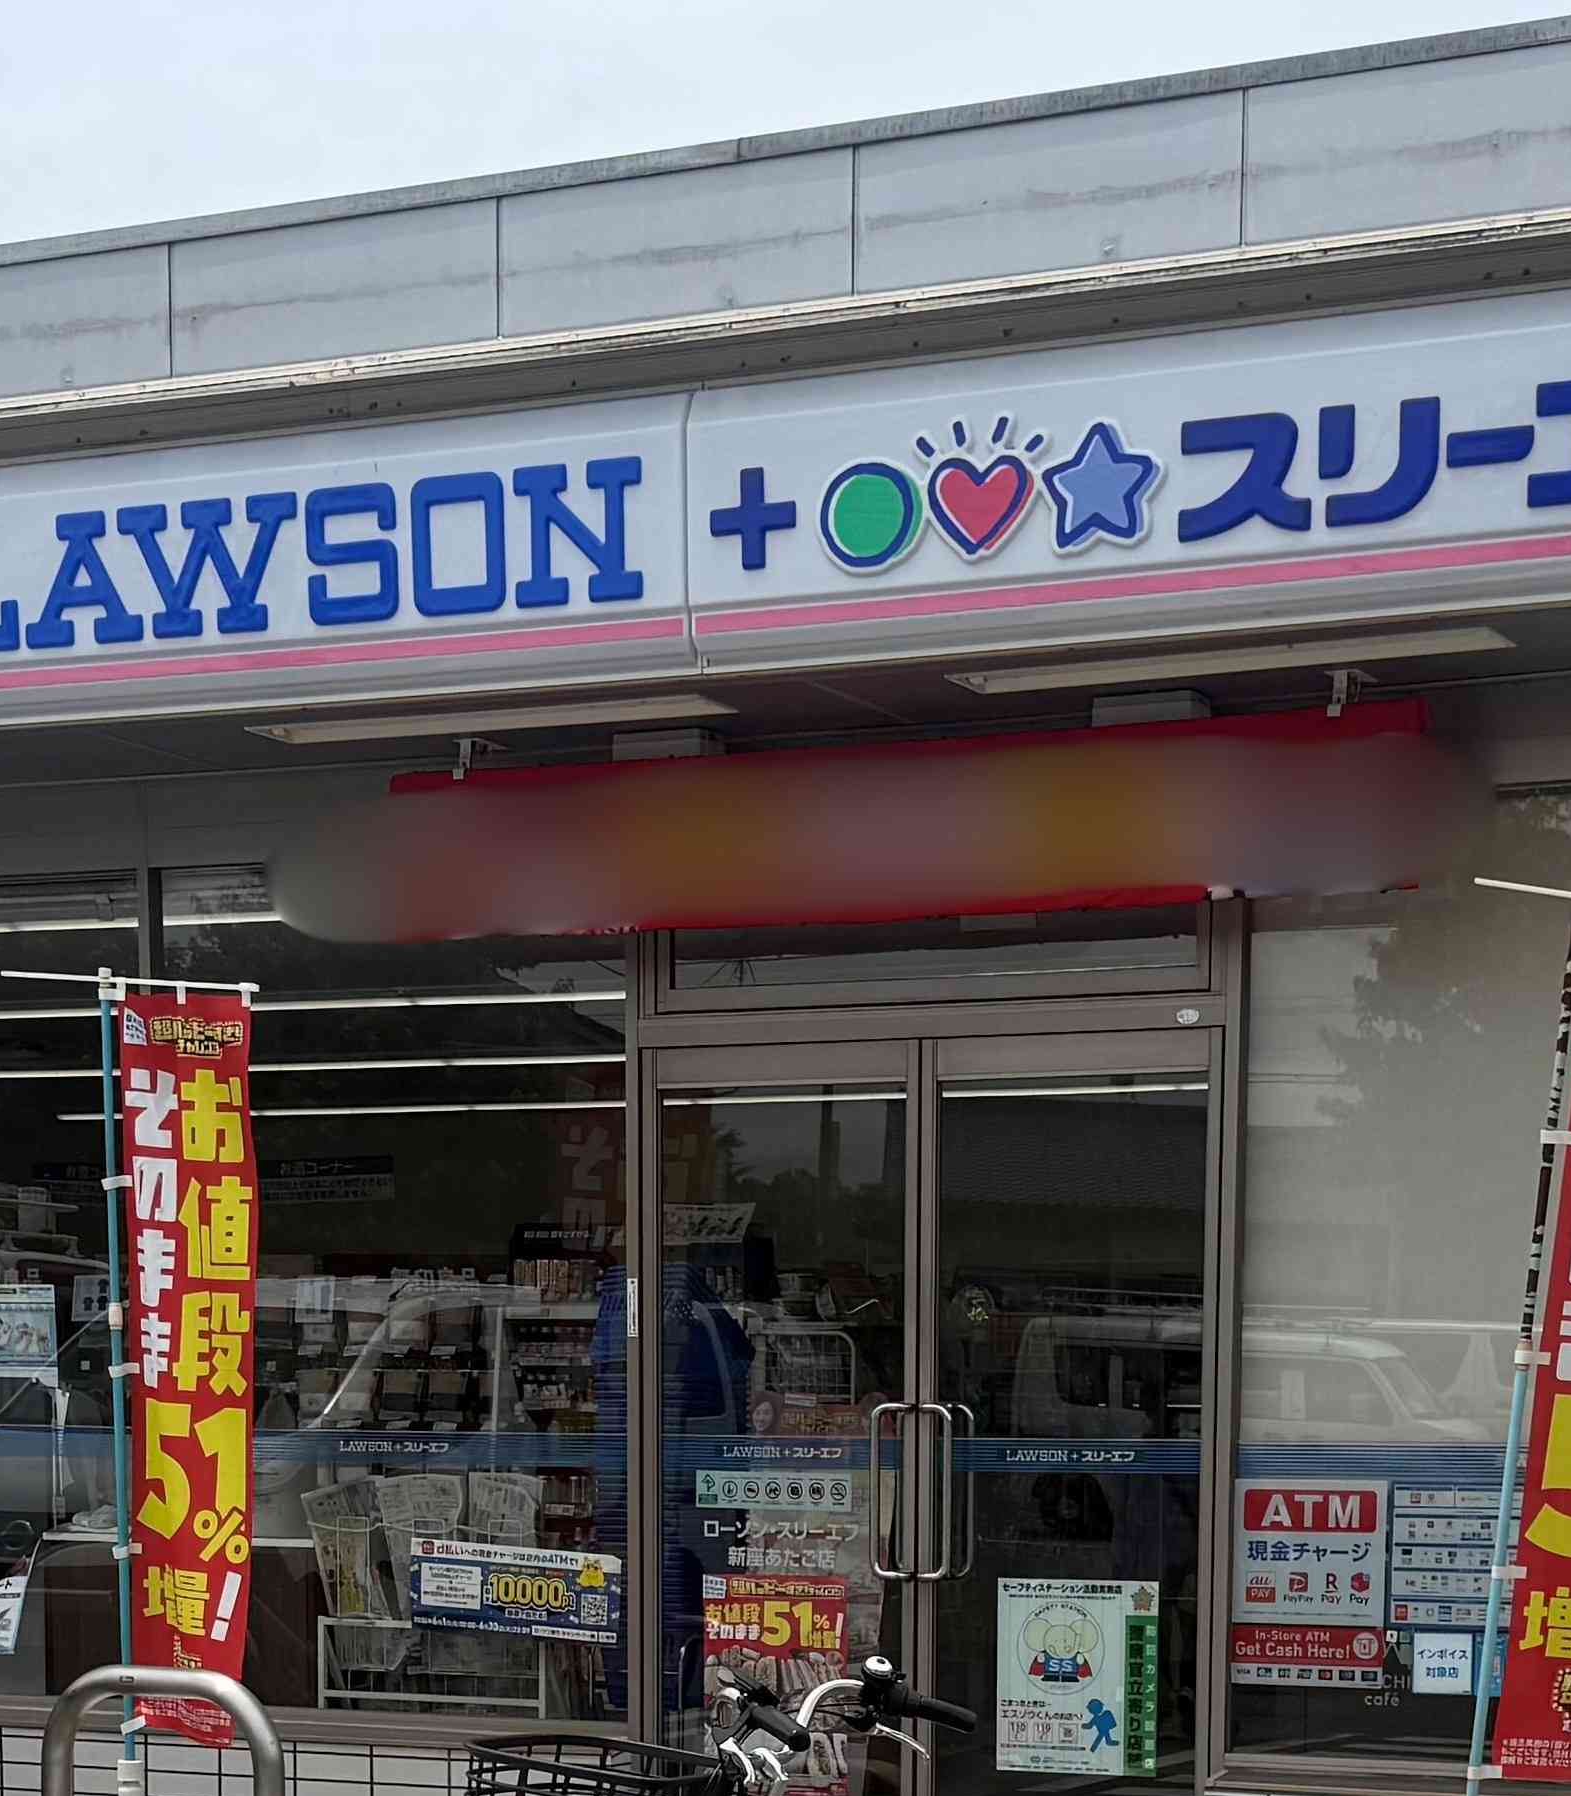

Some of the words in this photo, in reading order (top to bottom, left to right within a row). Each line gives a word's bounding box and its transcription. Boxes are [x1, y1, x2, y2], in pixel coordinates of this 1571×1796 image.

[125, 1069, 178, 1388] そのまま
[172, 1069, 253, 1396] お値段
[339, 1441, 395, 1453] LAWSON
[403, 1441, 450, 1453] スリーエフ
[722, 1445, 780, 1458] LAWSON
[793, 1447, 842, 1458] スリーエフ
[1006, 1450, 1068, 1462] LAWSON
[1081, 1451, 1135, 1462] スリーエフ
[136, 1398, 250, 1564] 51%
[1260, 1493, 1361, 1529] ATM
[703, 1519, 860, 1542] ローソン・スリーエフ
[727, 1547, 836, 1568] 新座あたご店
[1247, 1540, 1372, 1563] 現金チャージ
[1251, 1588, 1271, 1598] PAY
[1349, 1594, 1370, 1606] Pay
[1255, 1630, 1301, 1641] In-Store
[1305, 1631, 1330, 1642] ATM
[1235, 1641, 1261, 1656] Get
[1264, 1642, 1302, 1658] Cash
[1307, 1644, 1350, 1659] Here!
[1417, 1648, 1469, 1661] インボイス
